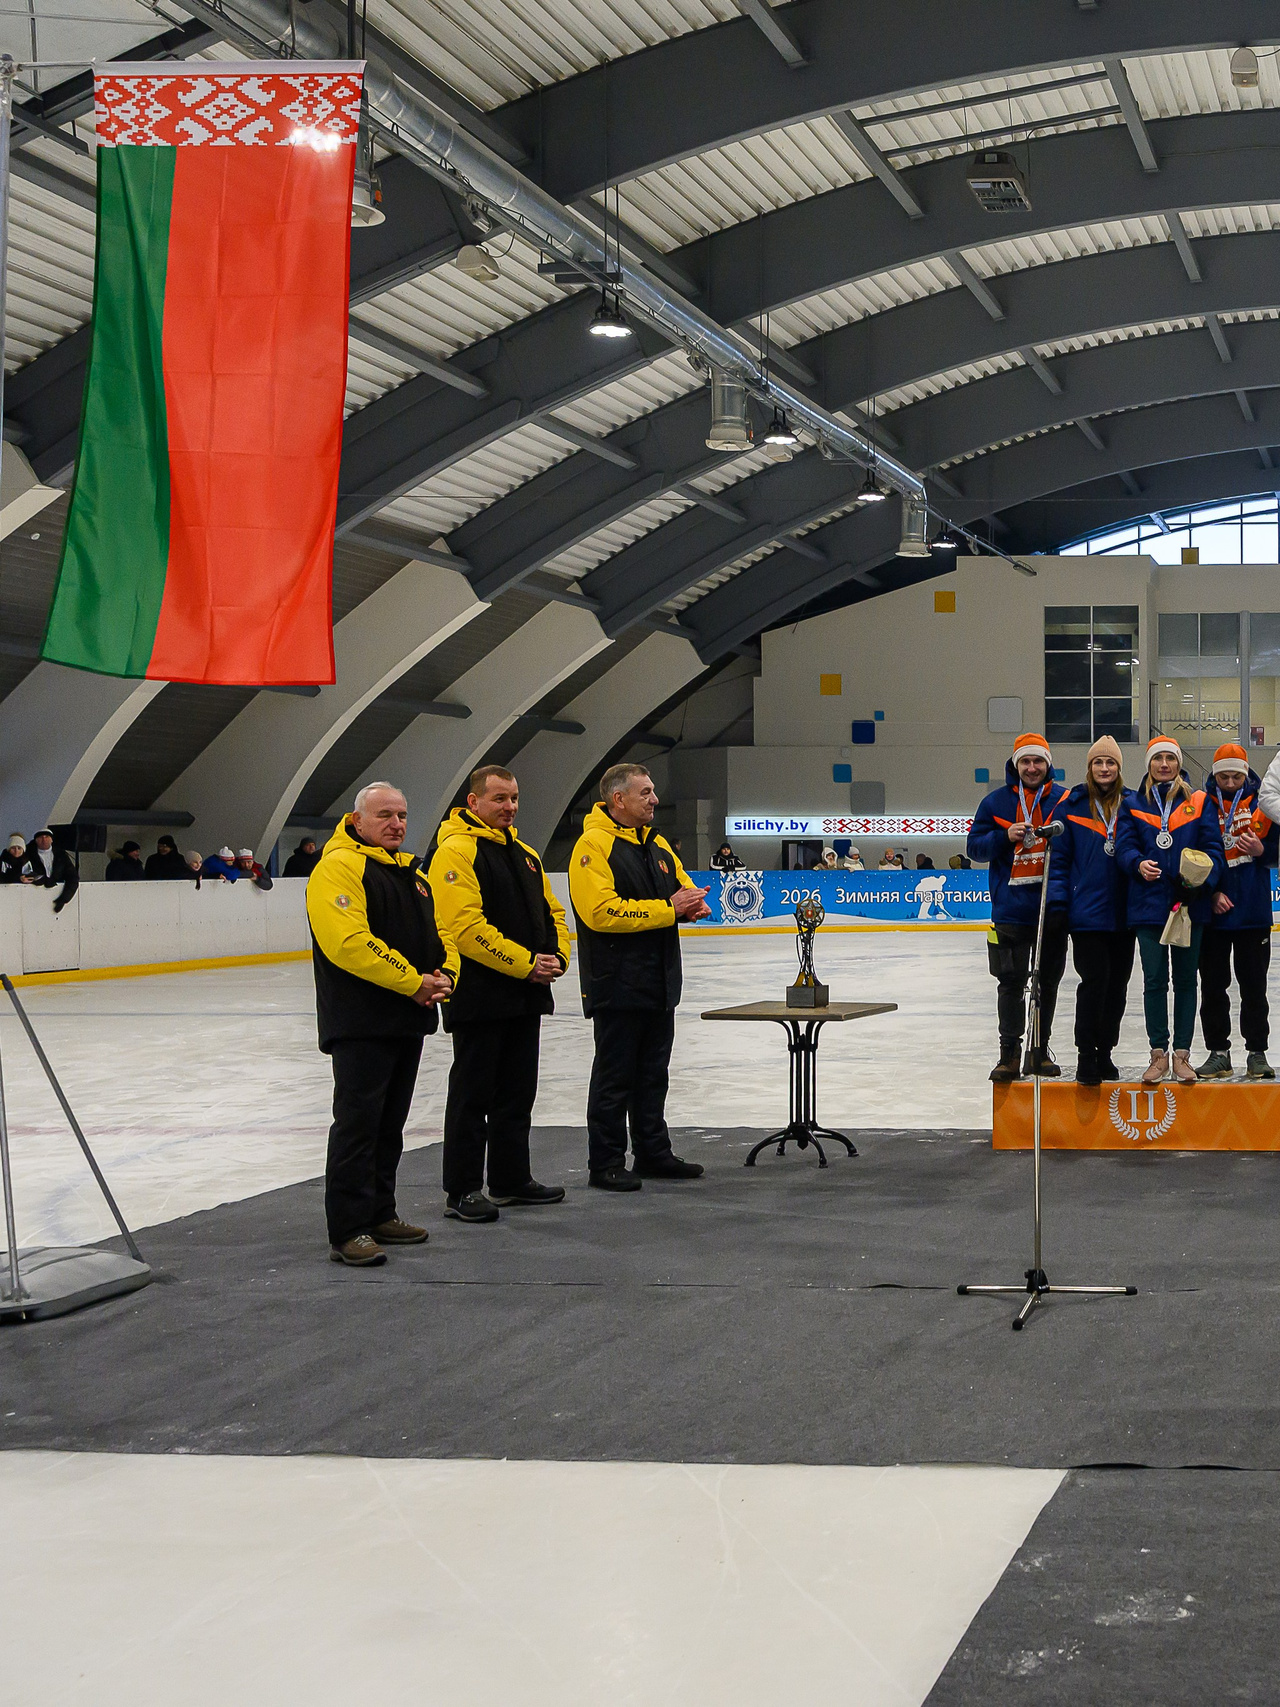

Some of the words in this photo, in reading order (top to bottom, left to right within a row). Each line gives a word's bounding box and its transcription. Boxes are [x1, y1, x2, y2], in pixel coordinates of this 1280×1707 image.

[734, 819, 809, 832] silichy.by
[780, 889, 821, 905] 2026
[835, 888, 900, 904] Зимняя
[607, 907, 650, 919] BELARUS
[366, 940, 407, 974] BELARUS
[475, 934, 515, 966] BELARUS
[1126, 1090, 1159, 1122] II
